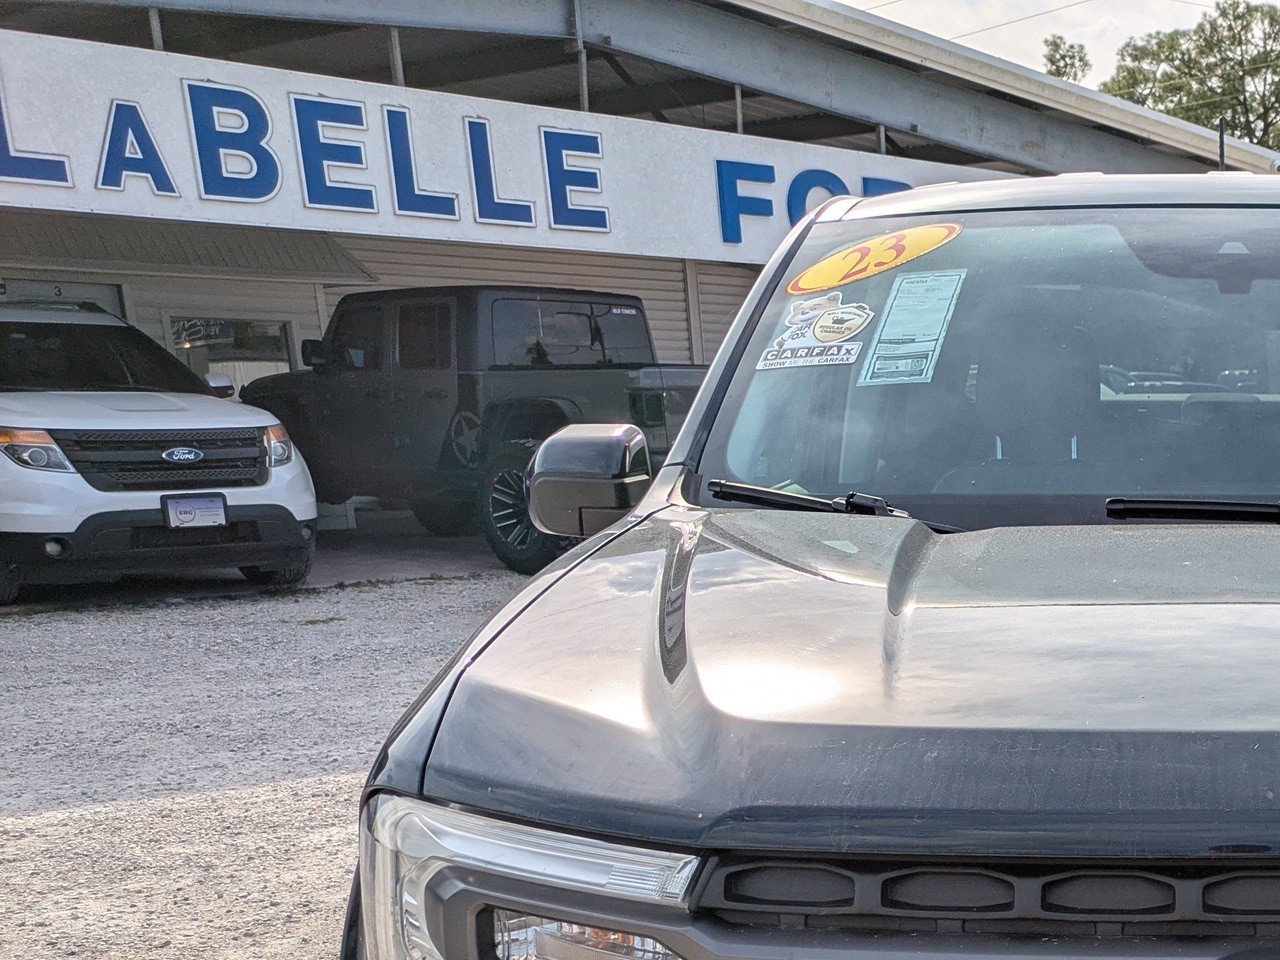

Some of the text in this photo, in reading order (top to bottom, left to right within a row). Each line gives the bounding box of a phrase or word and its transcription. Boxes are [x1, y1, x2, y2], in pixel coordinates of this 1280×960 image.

[0, 78, 913, 244] LABELLE FO
[838, 233, 907, 283] 23
[53, 285, 63, 297] 3
[787, 331, 809, 341] FOX
[766, 346, 855, 360] CARFAX
[762, 356, 851, 369] SHOW ME THE CARFAX
[173, 450, 196, 460] Ford
